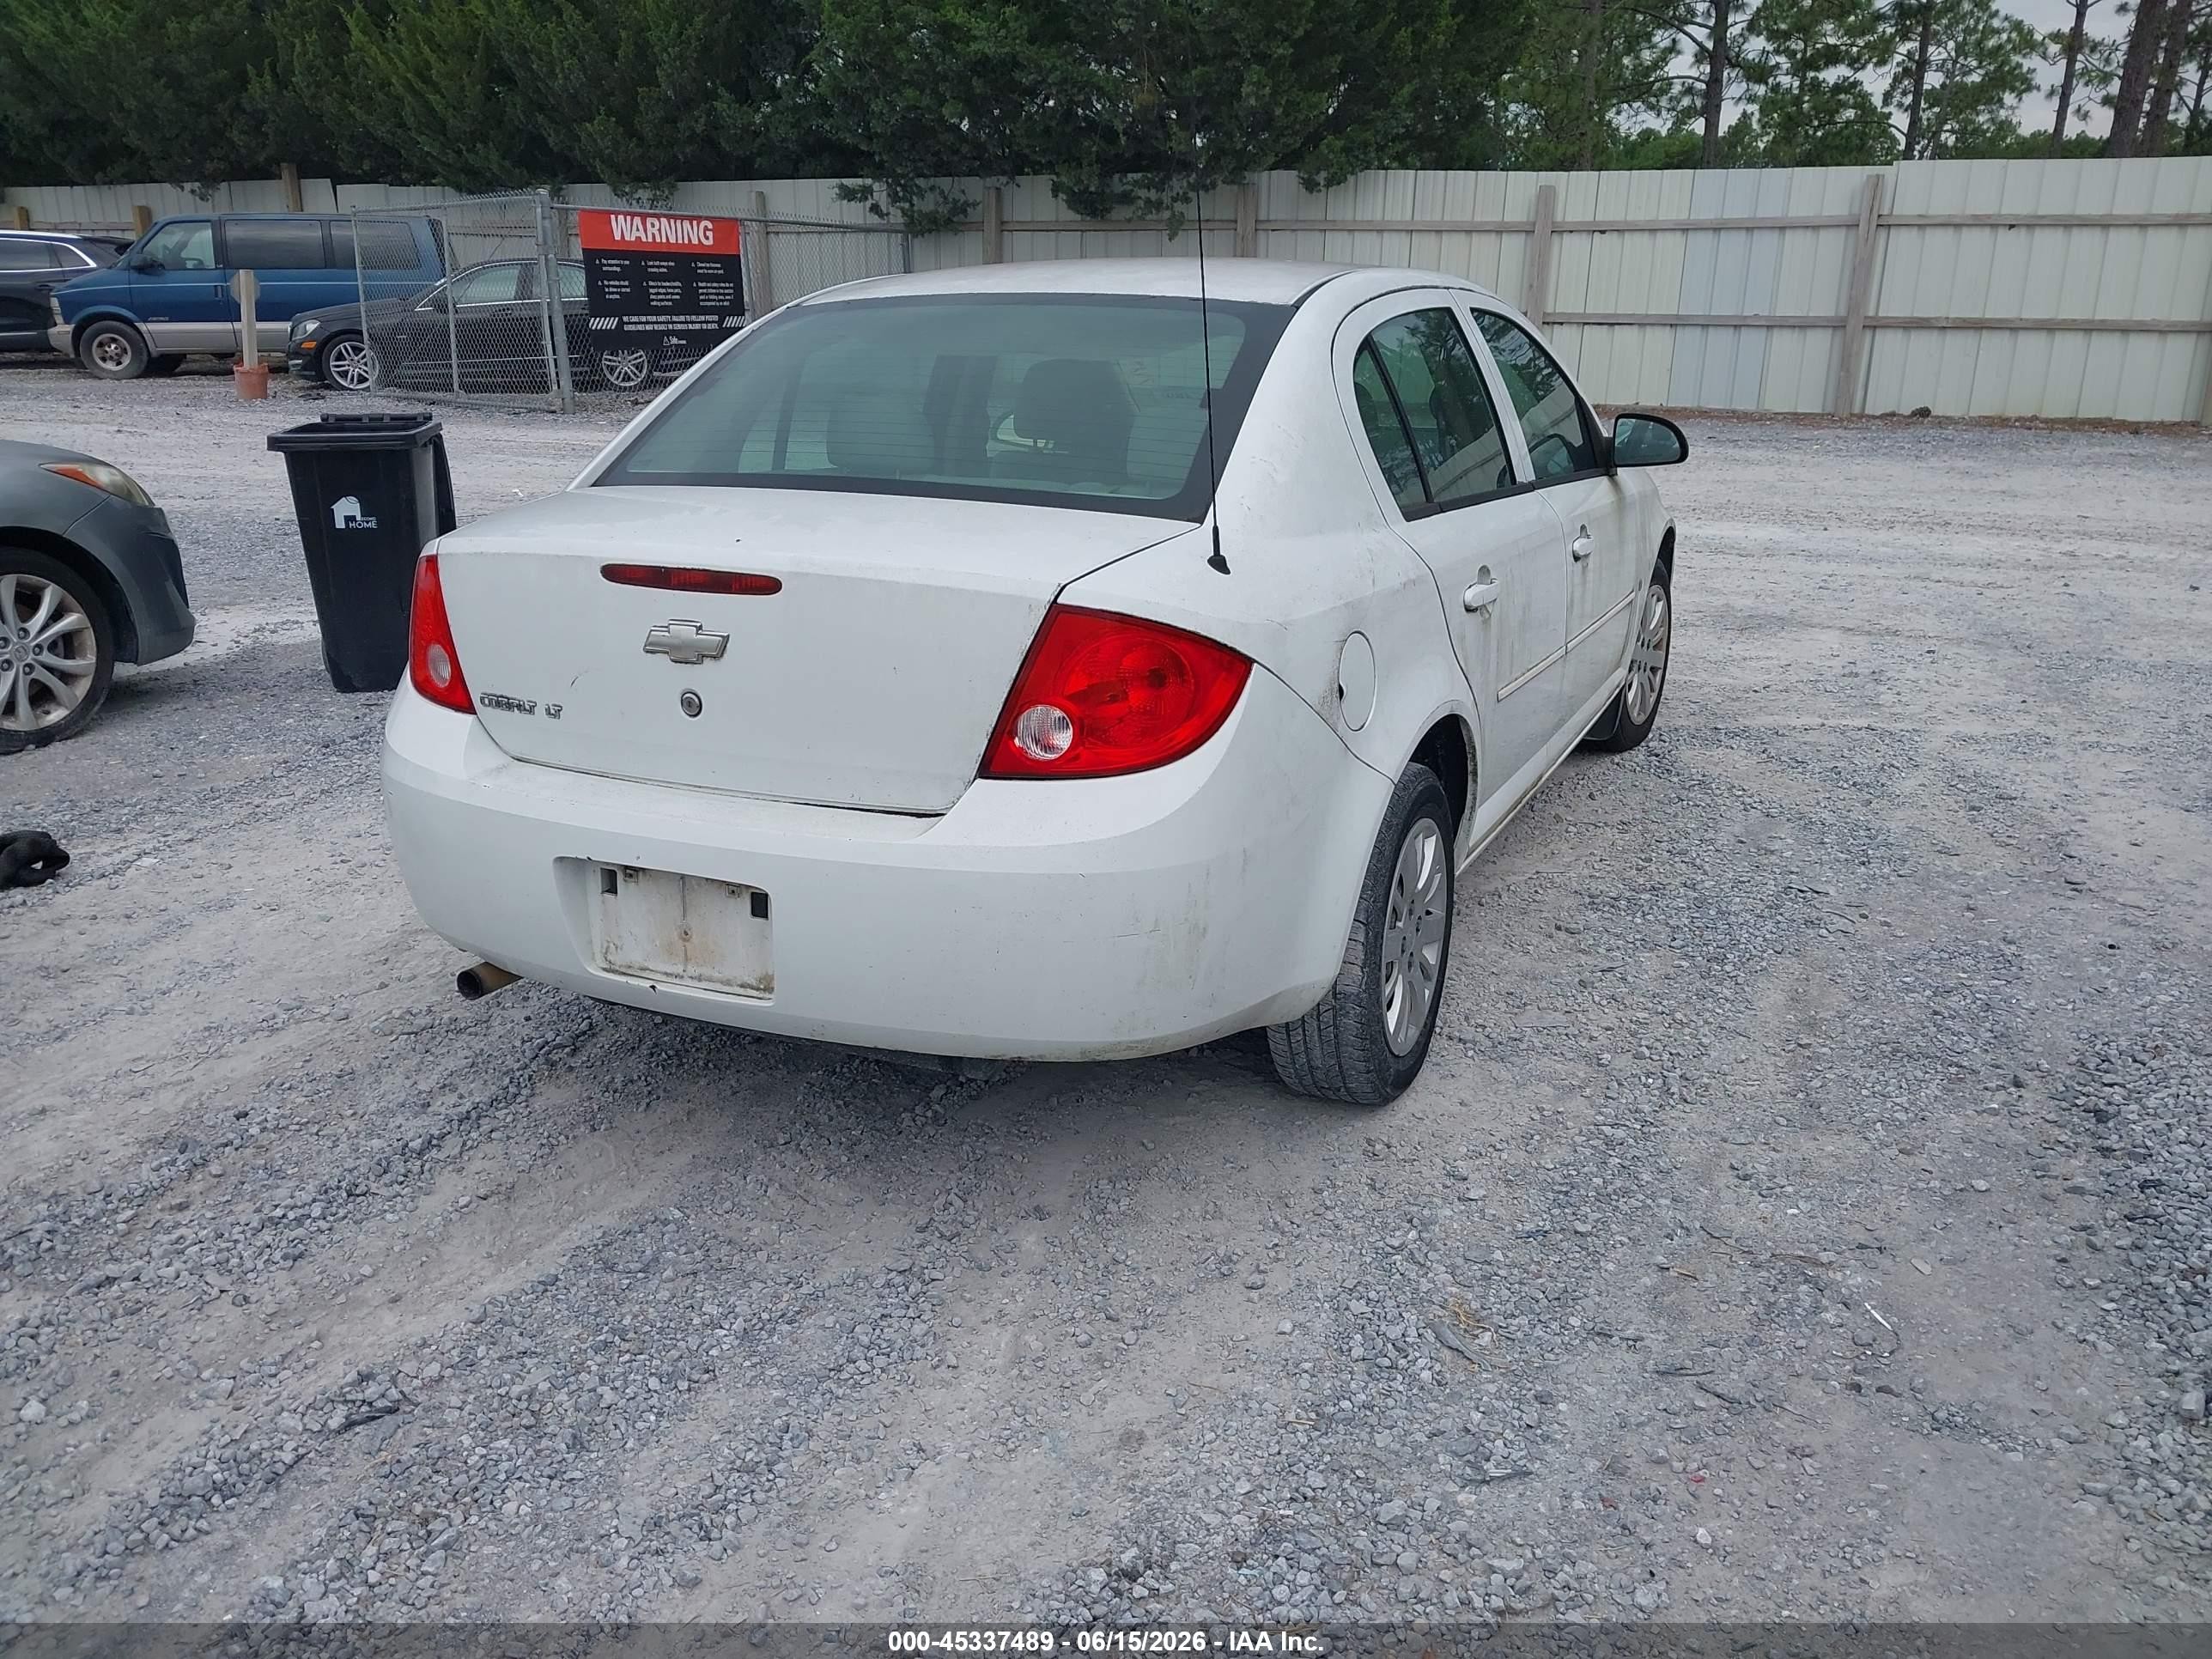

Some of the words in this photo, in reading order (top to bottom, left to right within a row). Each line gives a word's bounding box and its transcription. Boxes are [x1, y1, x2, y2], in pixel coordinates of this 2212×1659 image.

[610, 214, 714, 246] WARNING
[349, 520, 378, 529] HOME
[480, 693, 537, 715] COBALT
[544, 703, 563, 720] LT
